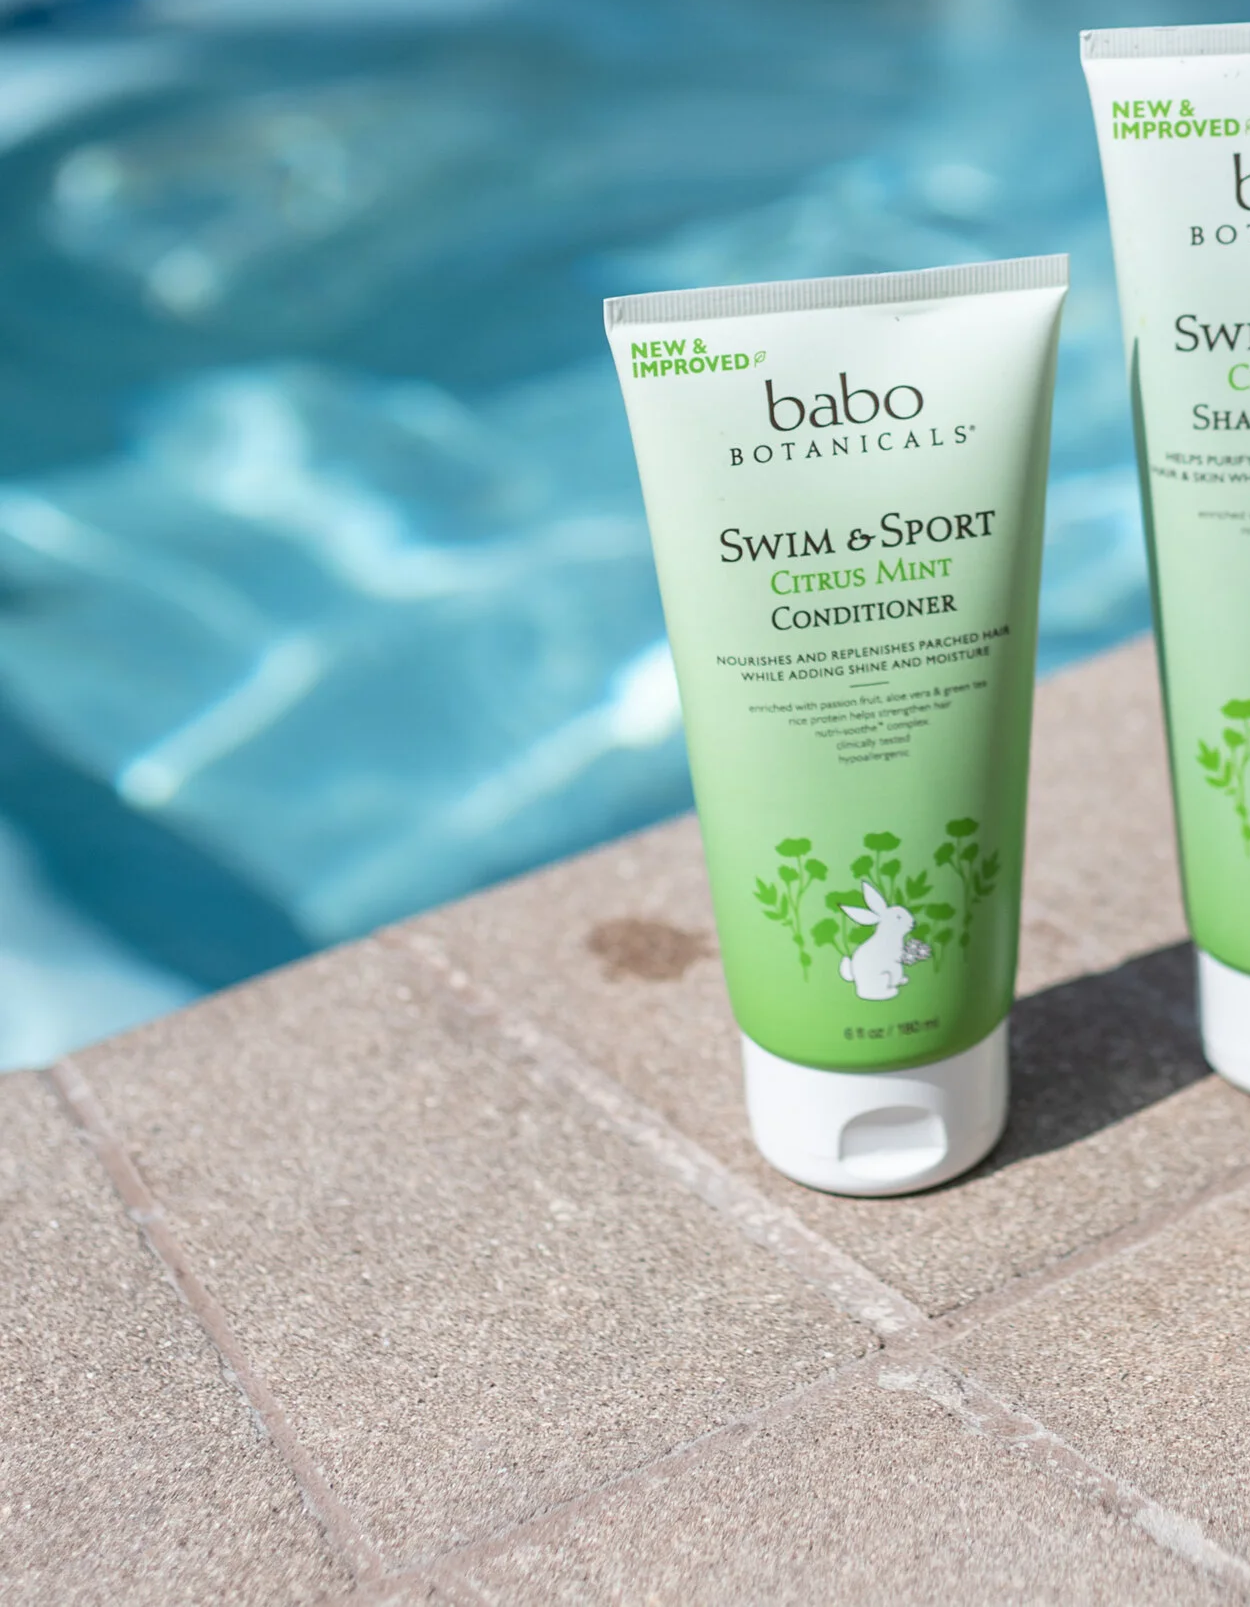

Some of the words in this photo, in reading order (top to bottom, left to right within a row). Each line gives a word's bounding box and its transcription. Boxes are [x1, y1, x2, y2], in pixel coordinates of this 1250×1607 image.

[1112, 99, 1172, 118] NEW
[1179, 98, 1195, 117] &
[1113, 118, 1240, 140] IMPROVED
[631, 339, 686, 359] NEW
[692, 338, 707, 355] &
[632, 353, 750, 378] IMPROVED
[765, 371, 924, 432] babo
[1165, 451, 1203, 465] HELPS
[1192, 471, 1225, 483] SKIN
[846, 527, 876, 552] &
[716, 654, 793, 667] NOURISHES
[796, 651, 827, 664] AND
[831, 641, 915, 661] REPLENISHES
[918, 633, 979, 650] PARCHED
[982, 624, 1010, 640] HAIR
[740, 670, 785, 682] WHILE
[788, 665, 845, 681] ADDING
[848, 660, 888, 675] SHINE
[891, 656, 922, 670] AND
[926, 646, 990, 665] MOISTURE
[795, 701, 817, 712] with
